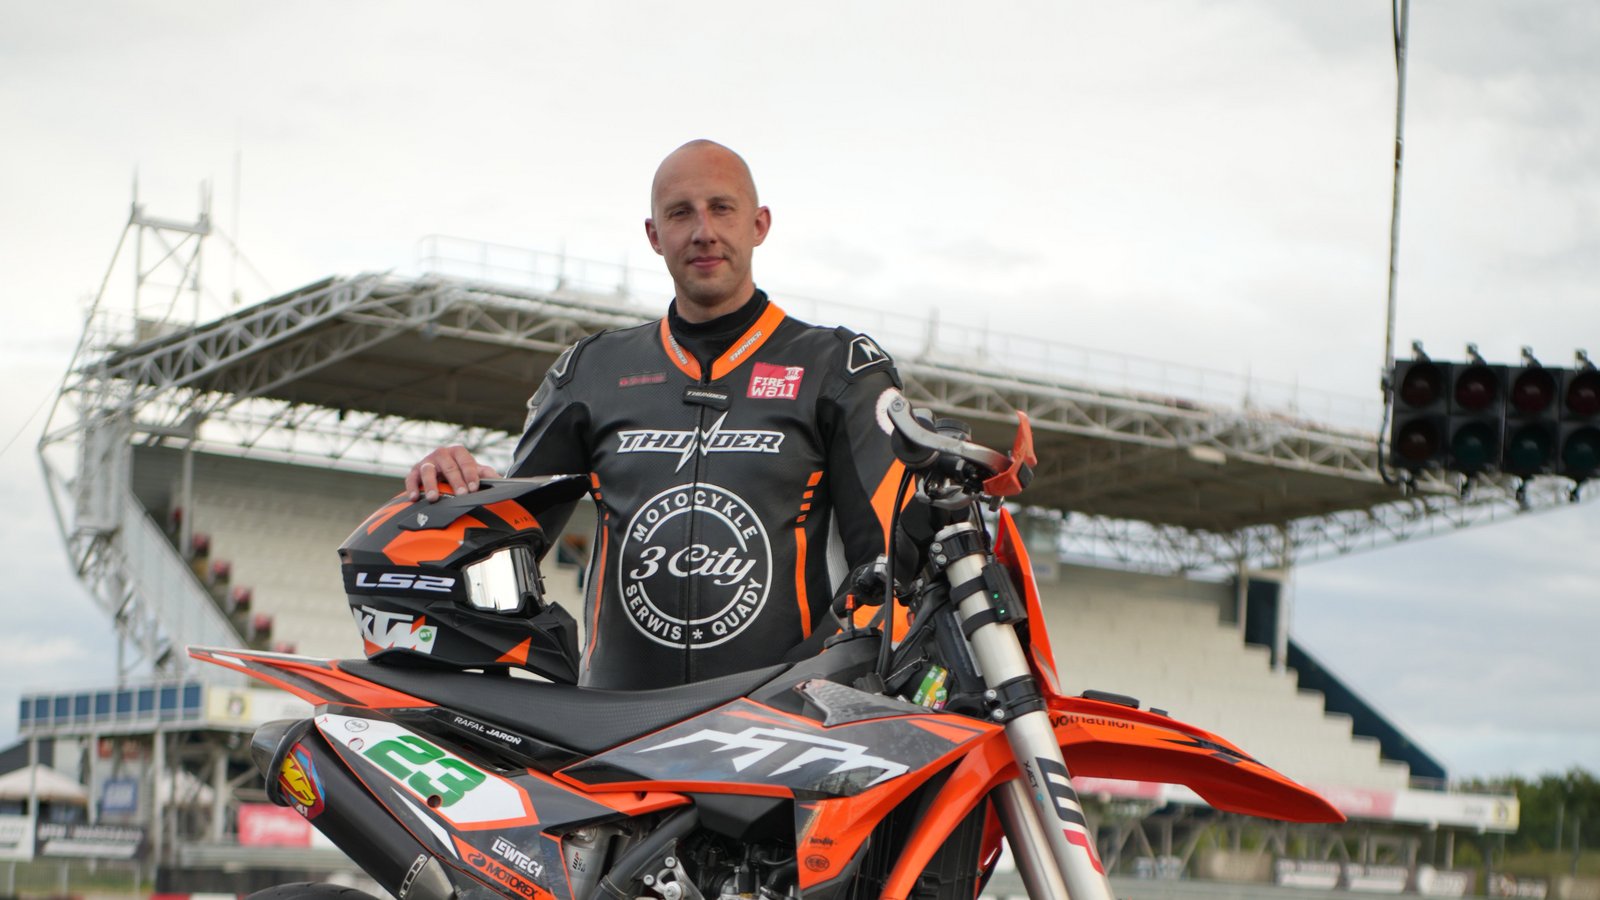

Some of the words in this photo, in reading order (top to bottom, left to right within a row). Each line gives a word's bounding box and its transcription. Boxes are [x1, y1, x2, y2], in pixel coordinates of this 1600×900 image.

[687, 390, 728, 400] THUNDER
[753, 376, 785, 388] FIRE
[632, 490, 759, 543] MOTOCYKLE
[355, 572, 456, 593] LS2
[629, 545, 667, 580] 3
[667, 543, 757, 586] City
[352, 604, 439, 655] KTM
[625, 583, 683, 641] SERWIS
[711, 577, 763, 636] QUADY
[362, 734, 488, 809] 23
[485, 861, 540, 900] MOTOREX
